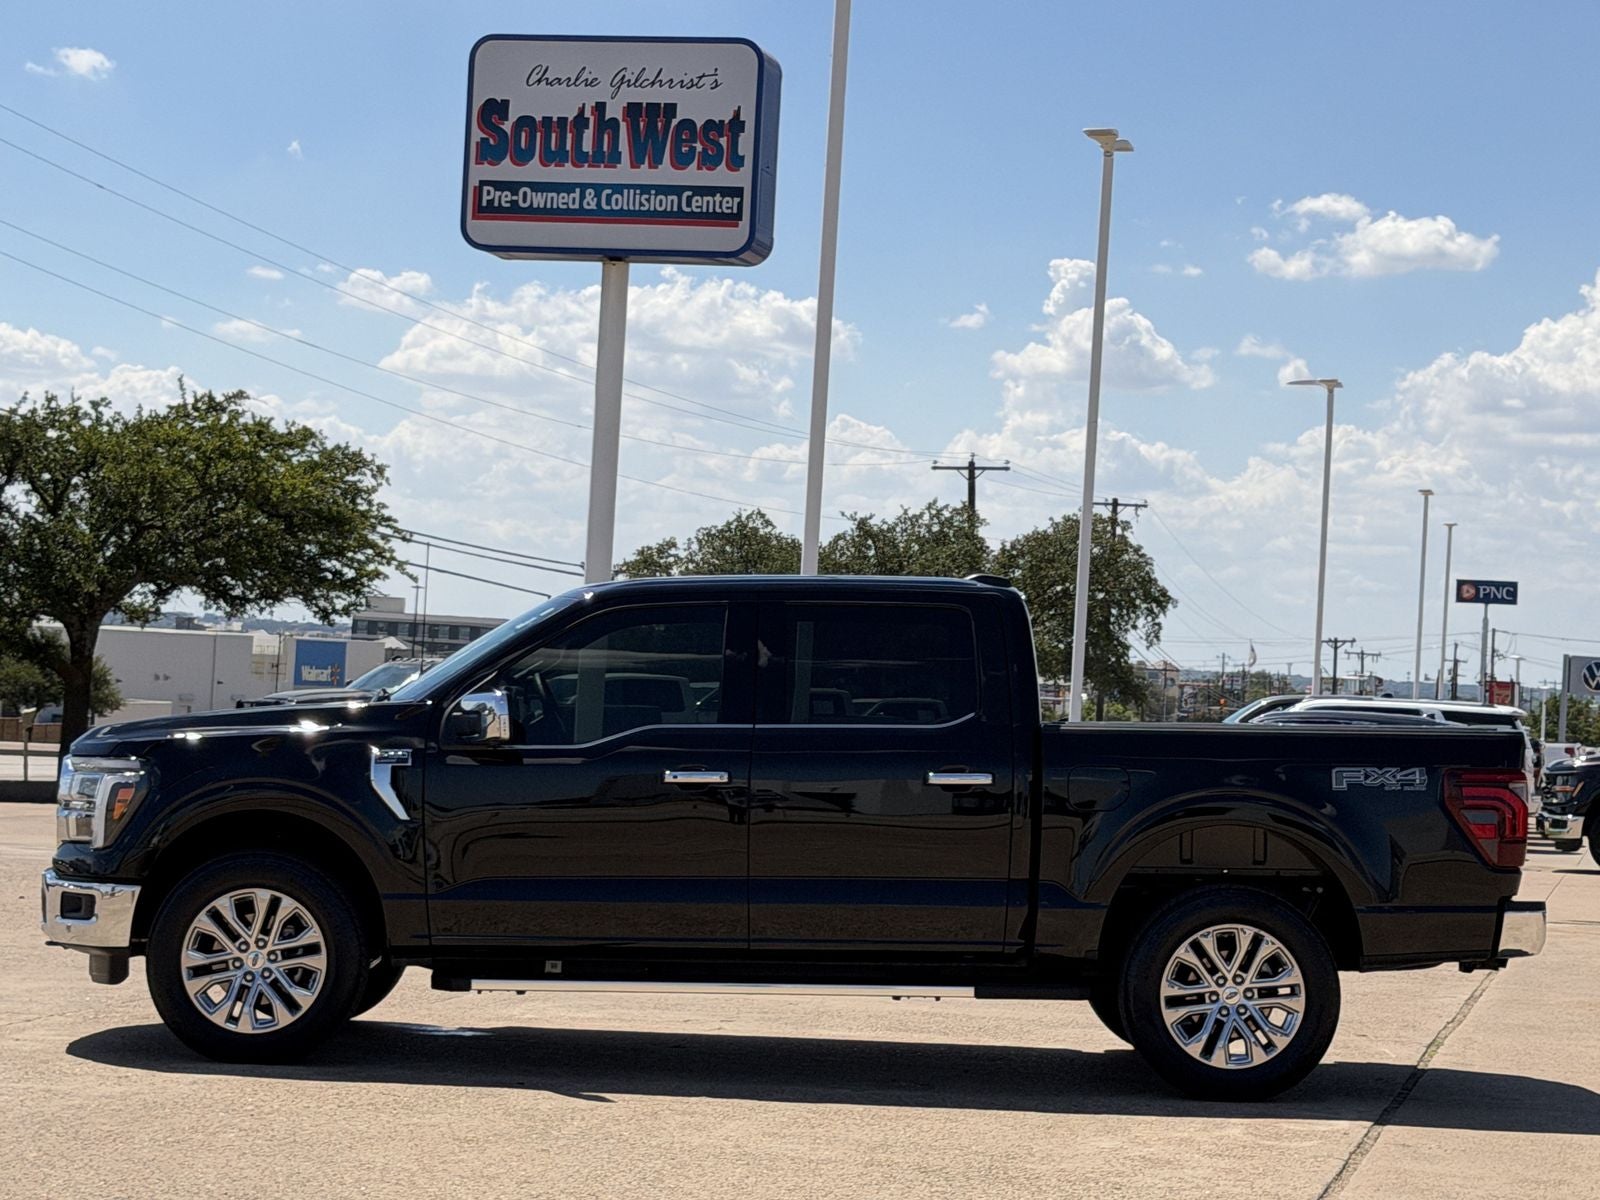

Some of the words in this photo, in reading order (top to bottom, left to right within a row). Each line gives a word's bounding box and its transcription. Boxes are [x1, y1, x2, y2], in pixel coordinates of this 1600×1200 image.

[525, 63, 602, 88] Charlie
[609, 67, 724, 100] Gilchrist's
[481, 185, 581, 210] Pre-Owned
[582, 188, 598, 211] &
[600, 188, 679, 213] Collision
[681, 190, 742, 215] Center
[1479, 585, 1514, 600] PNC
[1331, 766, 1428, 791] FX4
